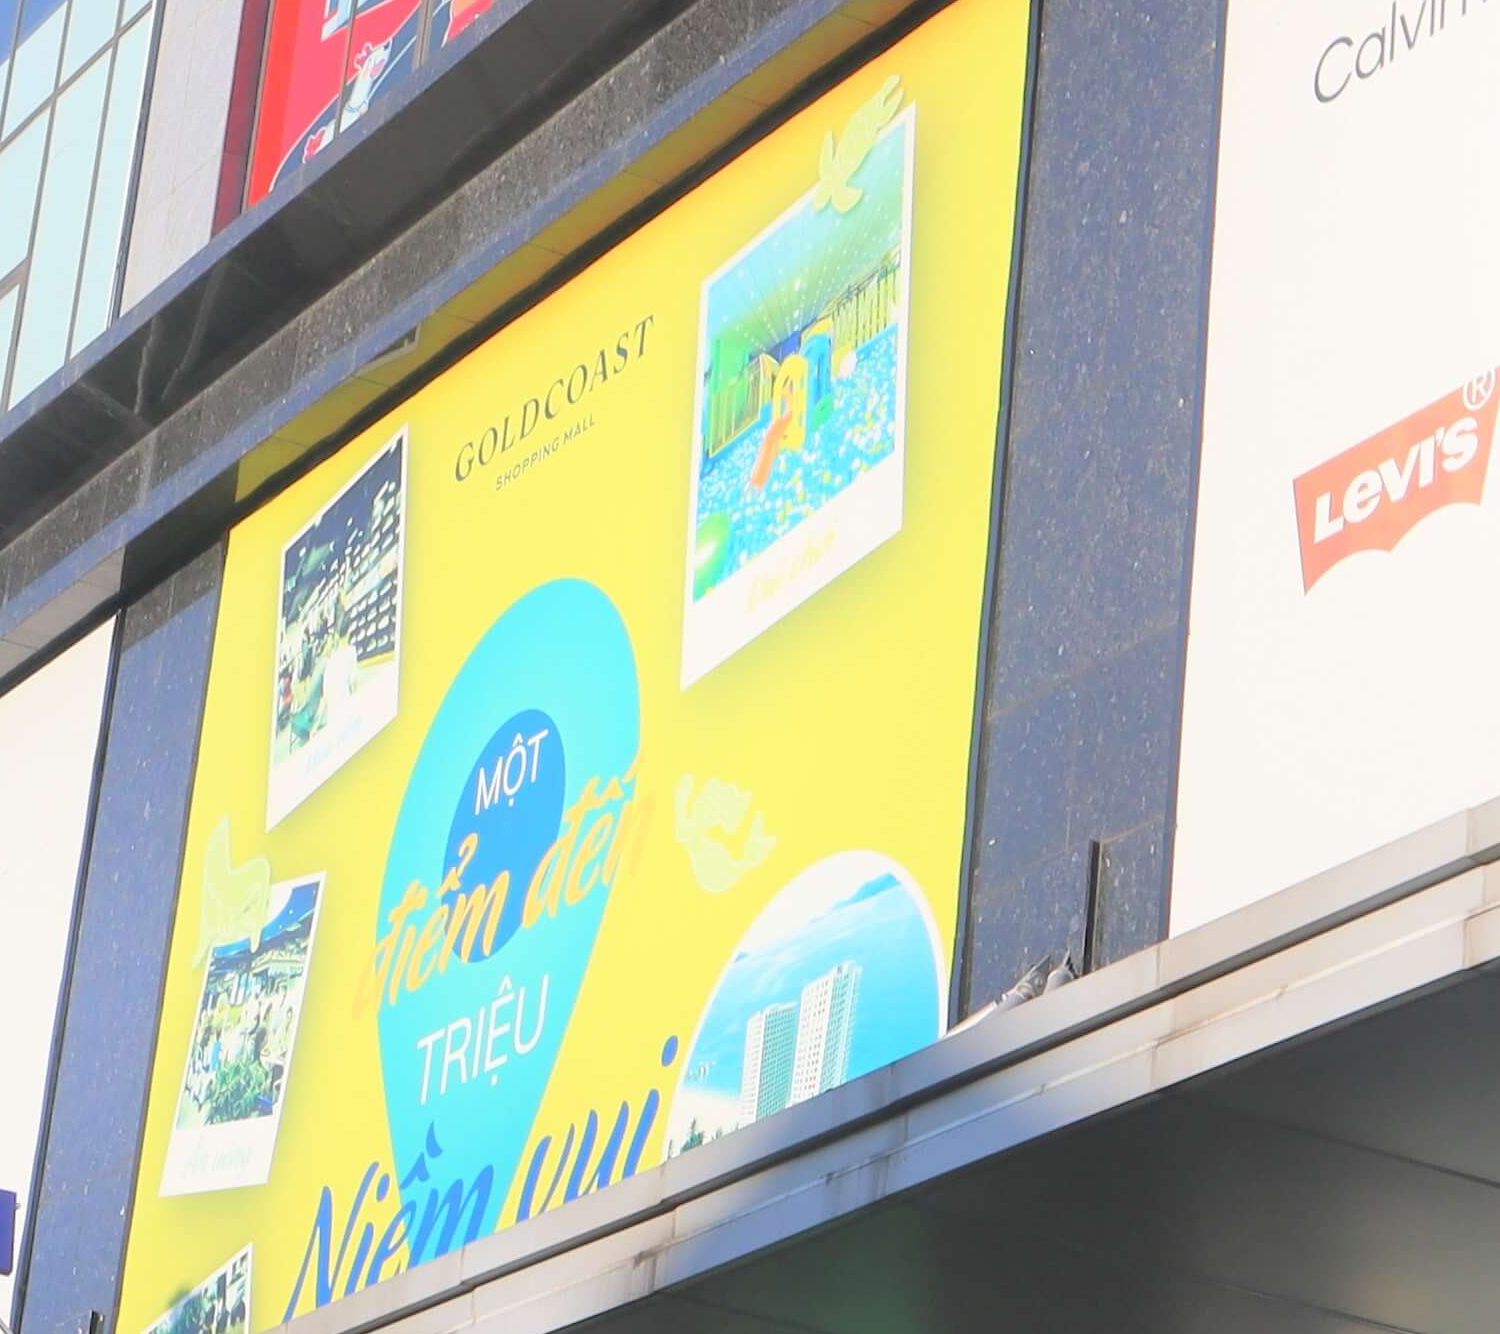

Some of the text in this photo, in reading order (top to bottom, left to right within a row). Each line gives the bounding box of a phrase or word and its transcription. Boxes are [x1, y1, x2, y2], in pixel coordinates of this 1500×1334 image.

[454, 315, 655, 482] GOLDCOAST
[495, 415, 596, 491] SHOPPING MALL
[474, 729, 549, 815] MỘT
[352, 750, 657, 1022] điểm đến
[416, 973, 551, 1105] TRIỆU
[282, 1120, 494, 1323] Niềm
